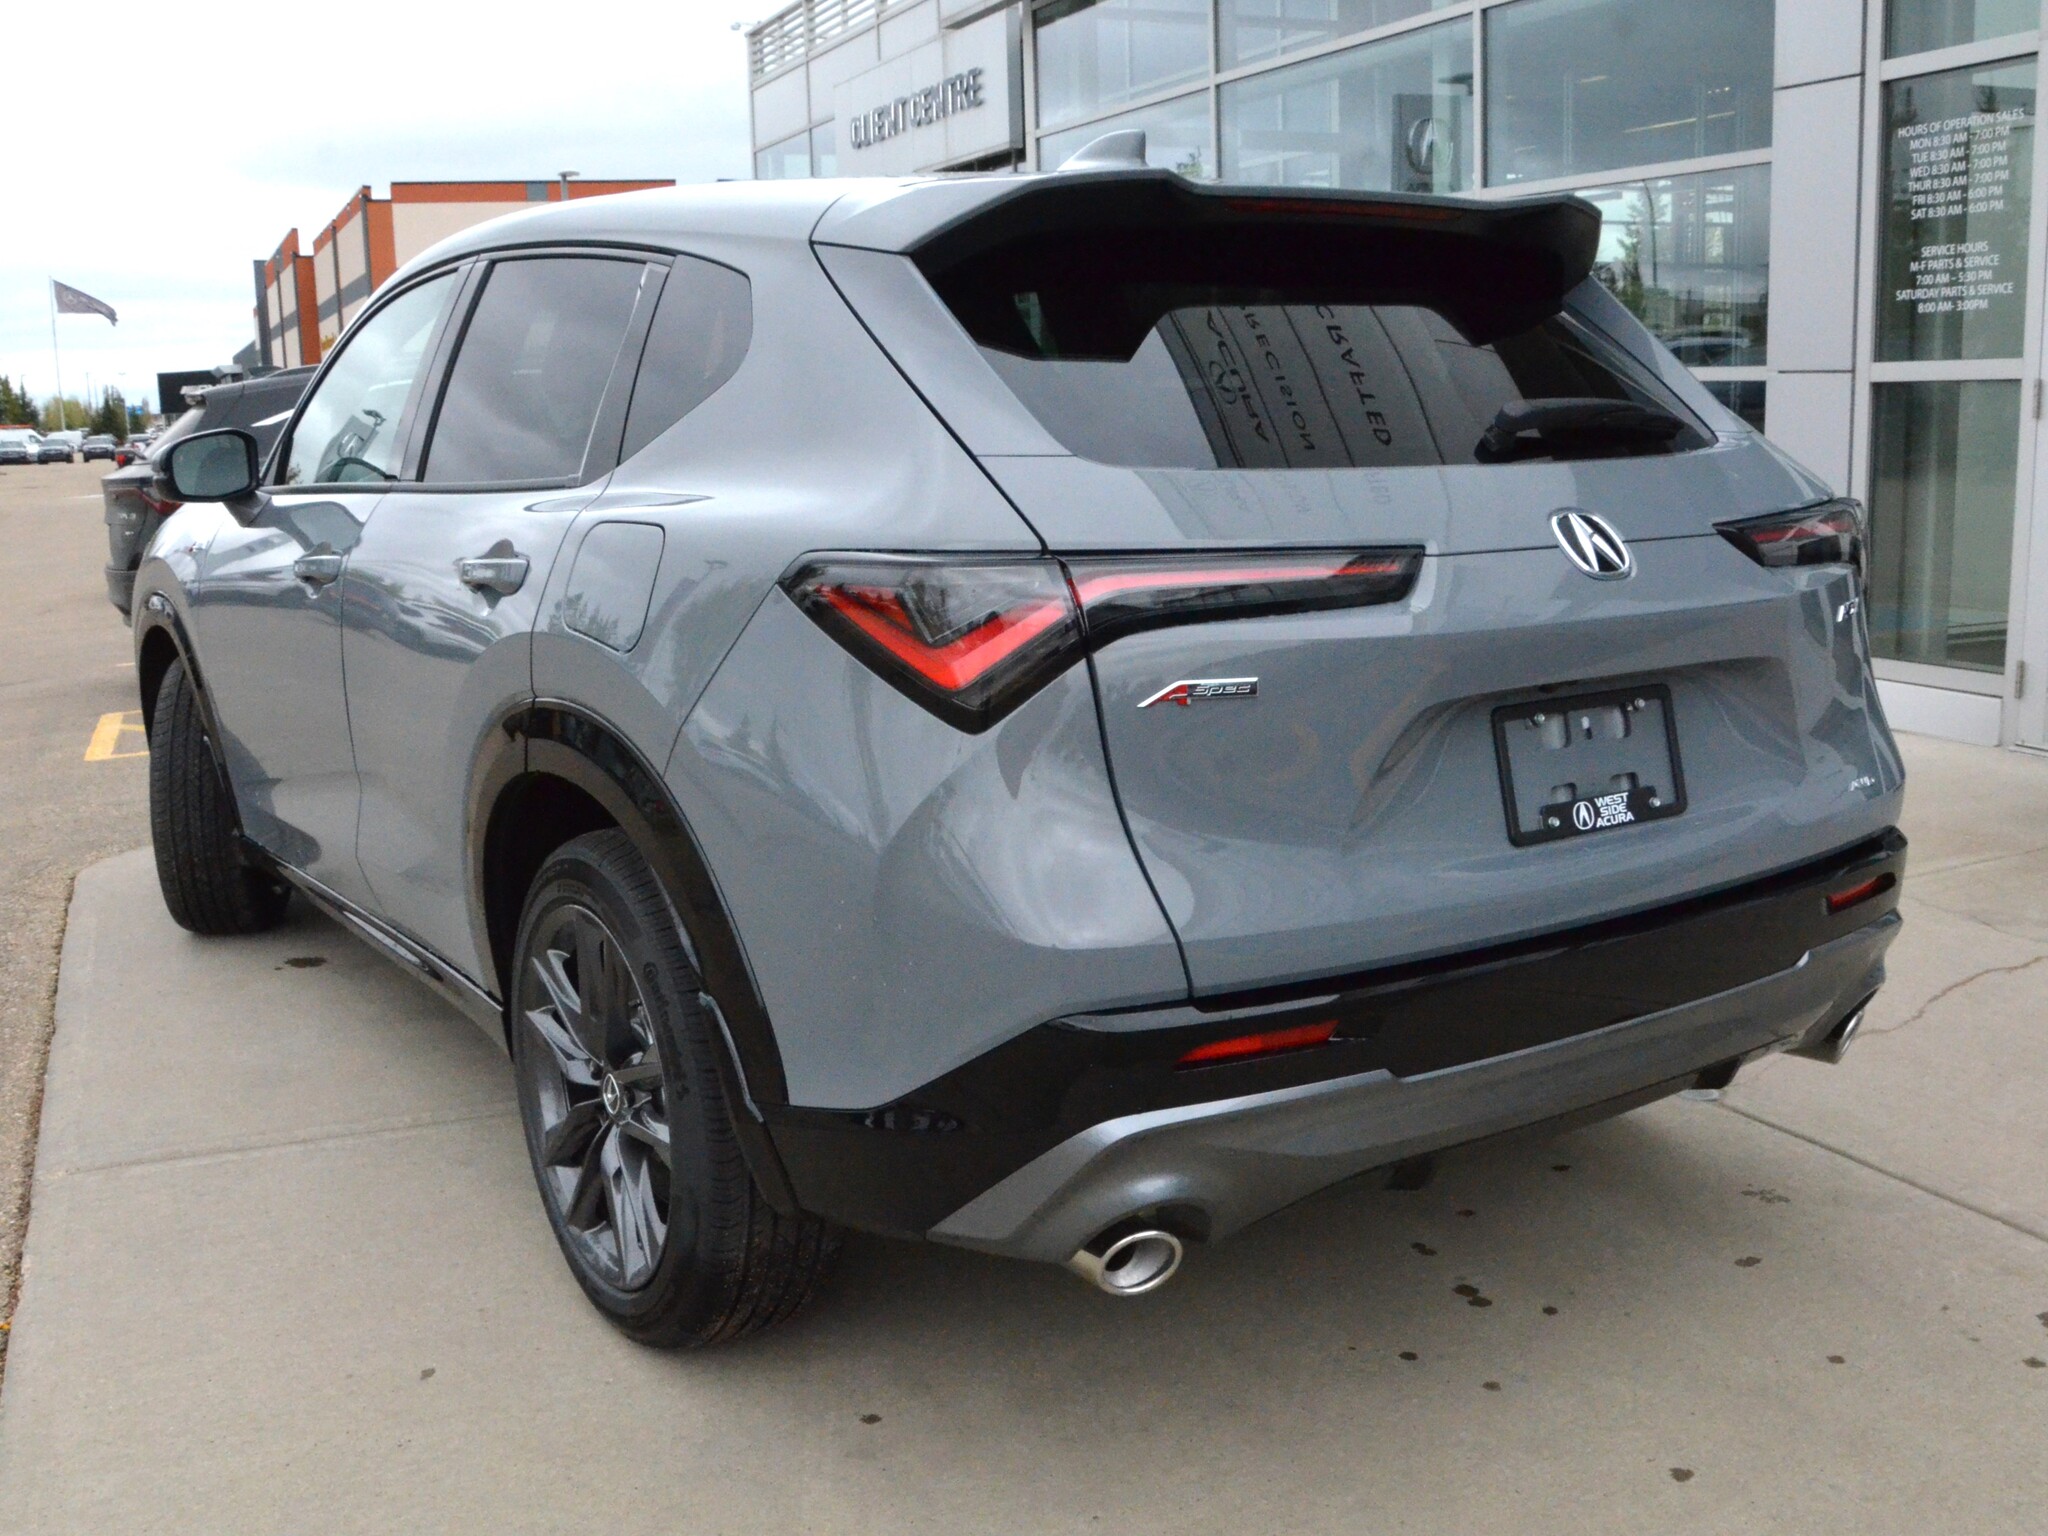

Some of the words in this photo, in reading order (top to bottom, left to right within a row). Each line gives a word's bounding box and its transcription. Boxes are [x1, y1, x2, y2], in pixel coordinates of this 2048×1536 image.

[849, 97, 907, 149] CLIENT
[909, 67, 984, 127] CENTRE
[1898, 124, 1928, 138] HOURS
[1929, 121, 1942, 133] OF
[1943, 113, 1995, 131] OPERATION
[1996, 108, 2025, 122] SALES
[1910, 138, 1932, 150] MON
[1932, 134, 1952, 146] 8:30
[1952, 132, 1968, 143] AM
[1974, 129, 1993, 140] 7:00
[1995, 126, 2010, 137] PM
[1912, 152, 1929, 163] TUE
[1930, 149, 1948, 160] 8:30
[1949, 146, 1965, 158] AM
[1971, 144, 1990, 155] 7:00
[1992, 141, 2006, 152] PM
[1910, 166, 1930, 178] WED
[1932, 163, 1950, 175] 8:30
[1950, 161, 1966, 173] AM
[1973, 159, 1992, 170] 7:00
[1993, 156, 2008, 167] PM
[1908, 180, 1932, 192] THUR
[1932, 177, 1951, 189] 8:30
[1952, 175, 1967, 186] AM
[1974, 172, 1993, 183] 7:00
[1994, 169, 2009, 180] PM
[1912, 194, 1926, 206] FRI
[1926, 192, 1946, 204] 8:30
[1946, 190, 1962, 201] AM
[1968, 187, 1987, 200] 6:00
[1988, 186, 2003, 197] PM
[1910, 208, 1927, 220] SAT
[1928, 206, 1946, 218] 8:30
[1947, 204, 1962, 215] AM
[1968, 201, 1988, 213] 6:00
[1989, 199, 2004, 211] PM
[1921, 244, 1956, 258] SERVICE
[1956, 241, 1988, 254] HOURS
[1910, 261, 1926, 272] M-F
[1927, 258, 1954, 271] PARTS
[1955, 258, 1962, 269] &
[1964, 254, 2000, 268] SERVICE
[1916, 274, 1934, 286] 7:00
[1935, 273, 1950, 284] AM
[1958, 271, 1976, 282] 5:30
[1978, 269, 1993, 280] PM
[1896, 288, 1940, 301] SATURDAY
[1941, 285, 1966, 297] PARTS
[1968, 284, 1976, 296] &
[1977, 282, 2014, 296] SERVICE
[1917, 302, 1936, 314] 8:00
[1594, 792, 1629, 807] WEST
[1596, 811, 1635, 828] ACURA
[1600, 803, 1628, 817] SIDE
